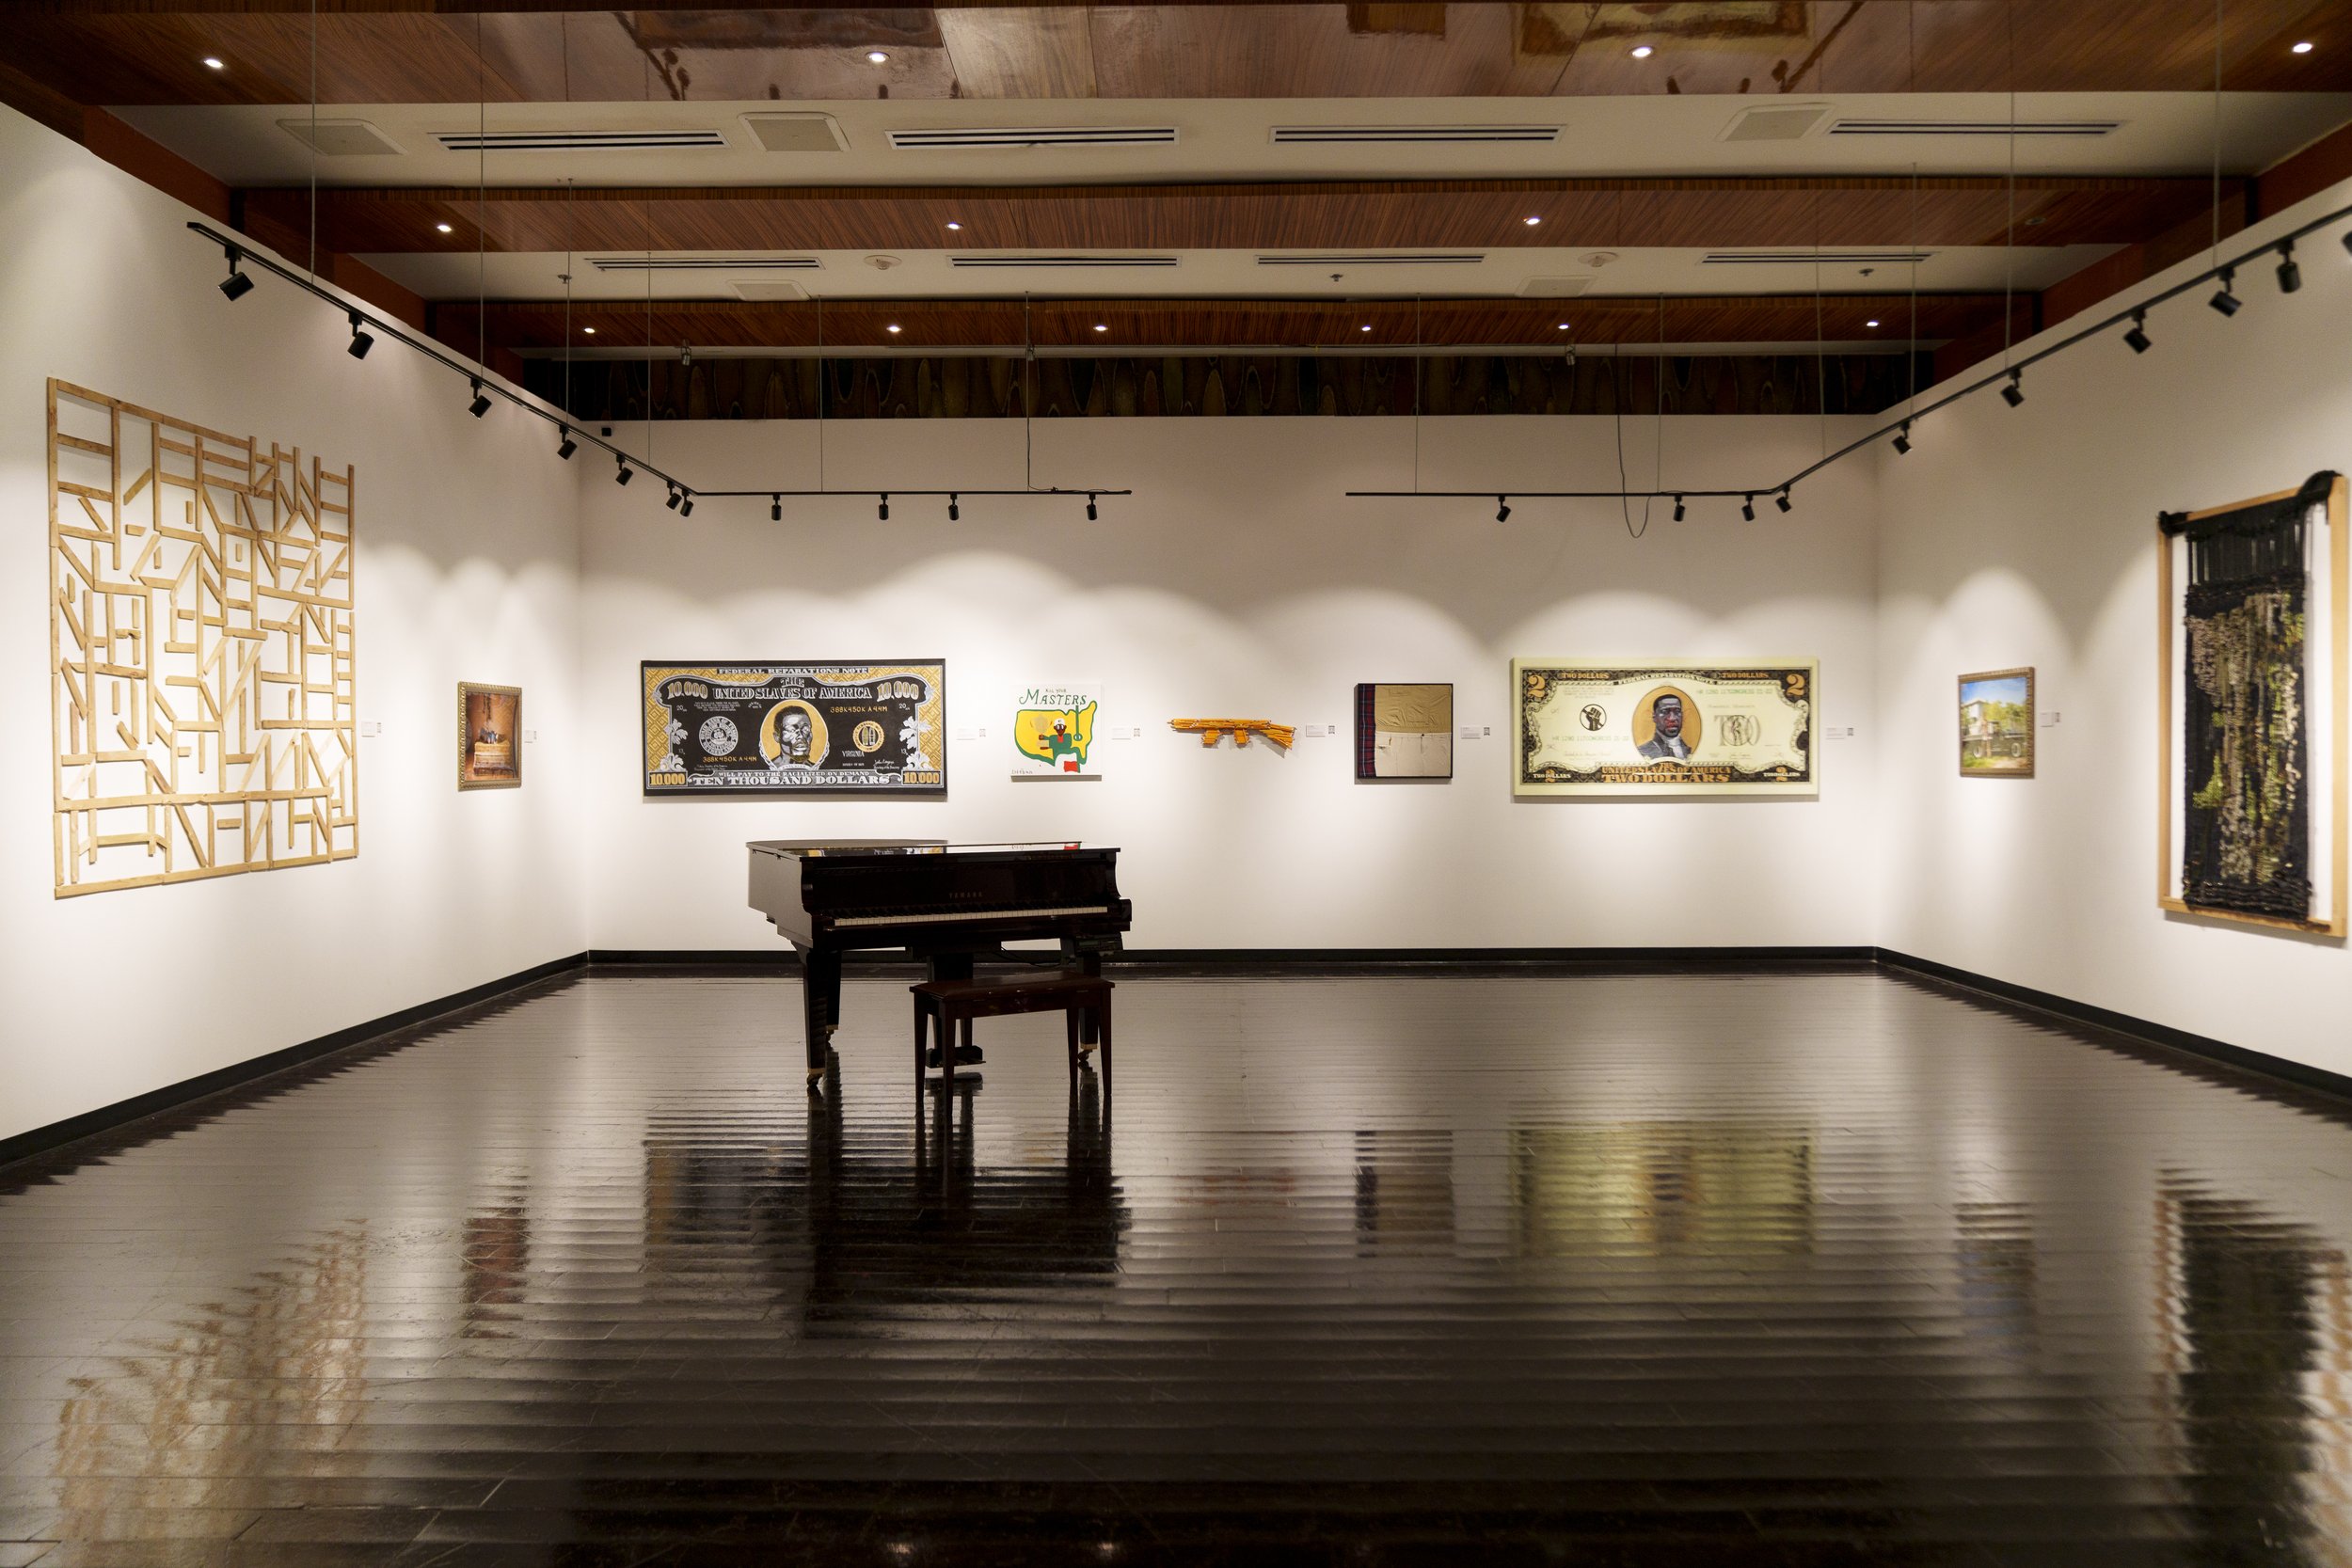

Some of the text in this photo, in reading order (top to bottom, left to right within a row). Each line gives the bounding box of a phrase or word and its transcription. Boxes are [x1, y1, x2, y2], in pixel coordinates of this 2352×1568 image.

[780, 676, 804, 689] THE
[1528, 674, 1546, 698] 2
[1786, 673, 1804, 696] 2
[712, 687, 872, 699] UNITED SLAVES OF AMERICA
[692, 776, 890, 785] TEN THOUSAND DOLLARS
[1601, 774, 1730, 783] TWO DOLLARS
